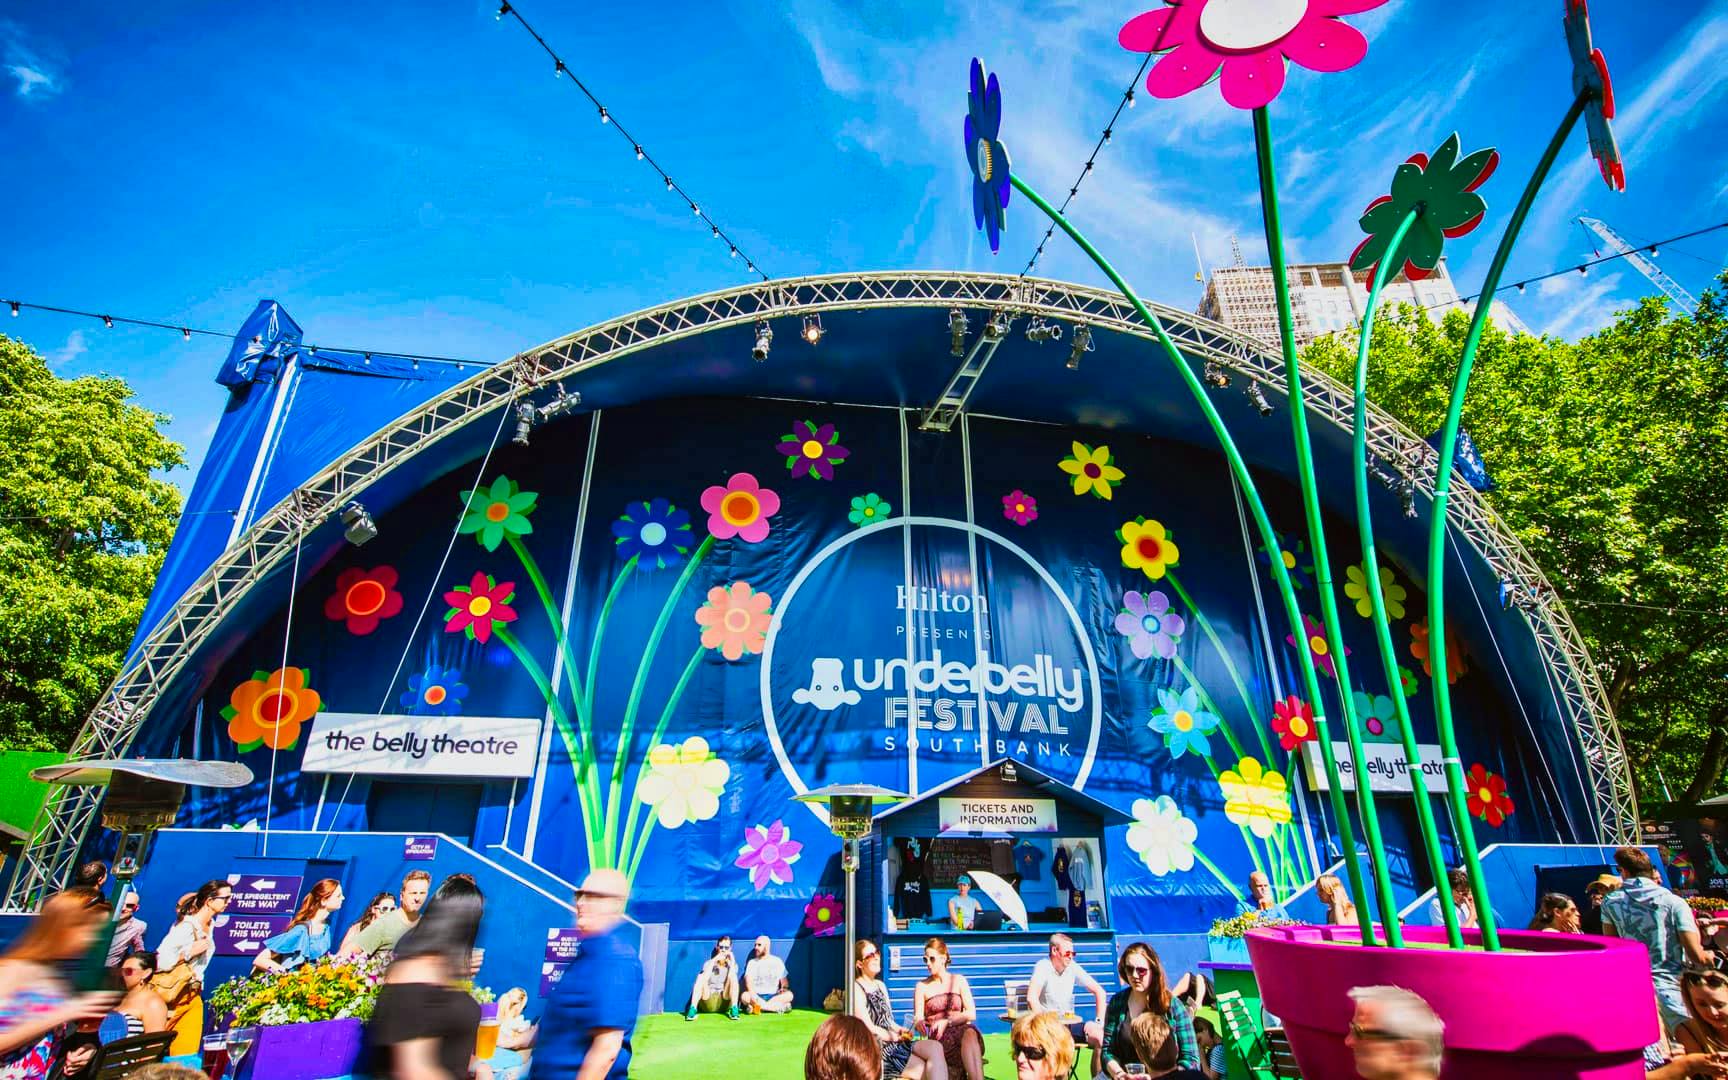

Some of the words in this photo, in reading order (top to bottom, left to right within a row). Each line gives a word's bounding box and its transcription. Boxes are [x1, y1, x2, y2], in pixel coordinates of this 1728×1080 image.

[895, 585, 989, 614] Hilton
[896, 625, 992, 640] PESENS
[853, 648, 1085, 713] underbelly
[884, 696, 1070, 735] FESTVAL
[325, 730, 365, 751] the
[372, 731, 428, 759] belly
[431, 733, 518, 755] theatre
[1367, 756, 1395, 779] elly
[1395, 757, 1444, 775] thatr
[961, 803, 1007, 814] TICKETS
[1011, 804, 1034, 814] AND
[960, 815, 1037, 825] INFORMATION
[231, 892, 243, 900] THE
[244, 893, 291, 901] SPIEGELTENT
[237, 900, 257, 908] THIS
[235, 921, 270, 930] TOILETS
[229, 930, 248, 938] THIS
[250, 930, 272, 938] WAY
